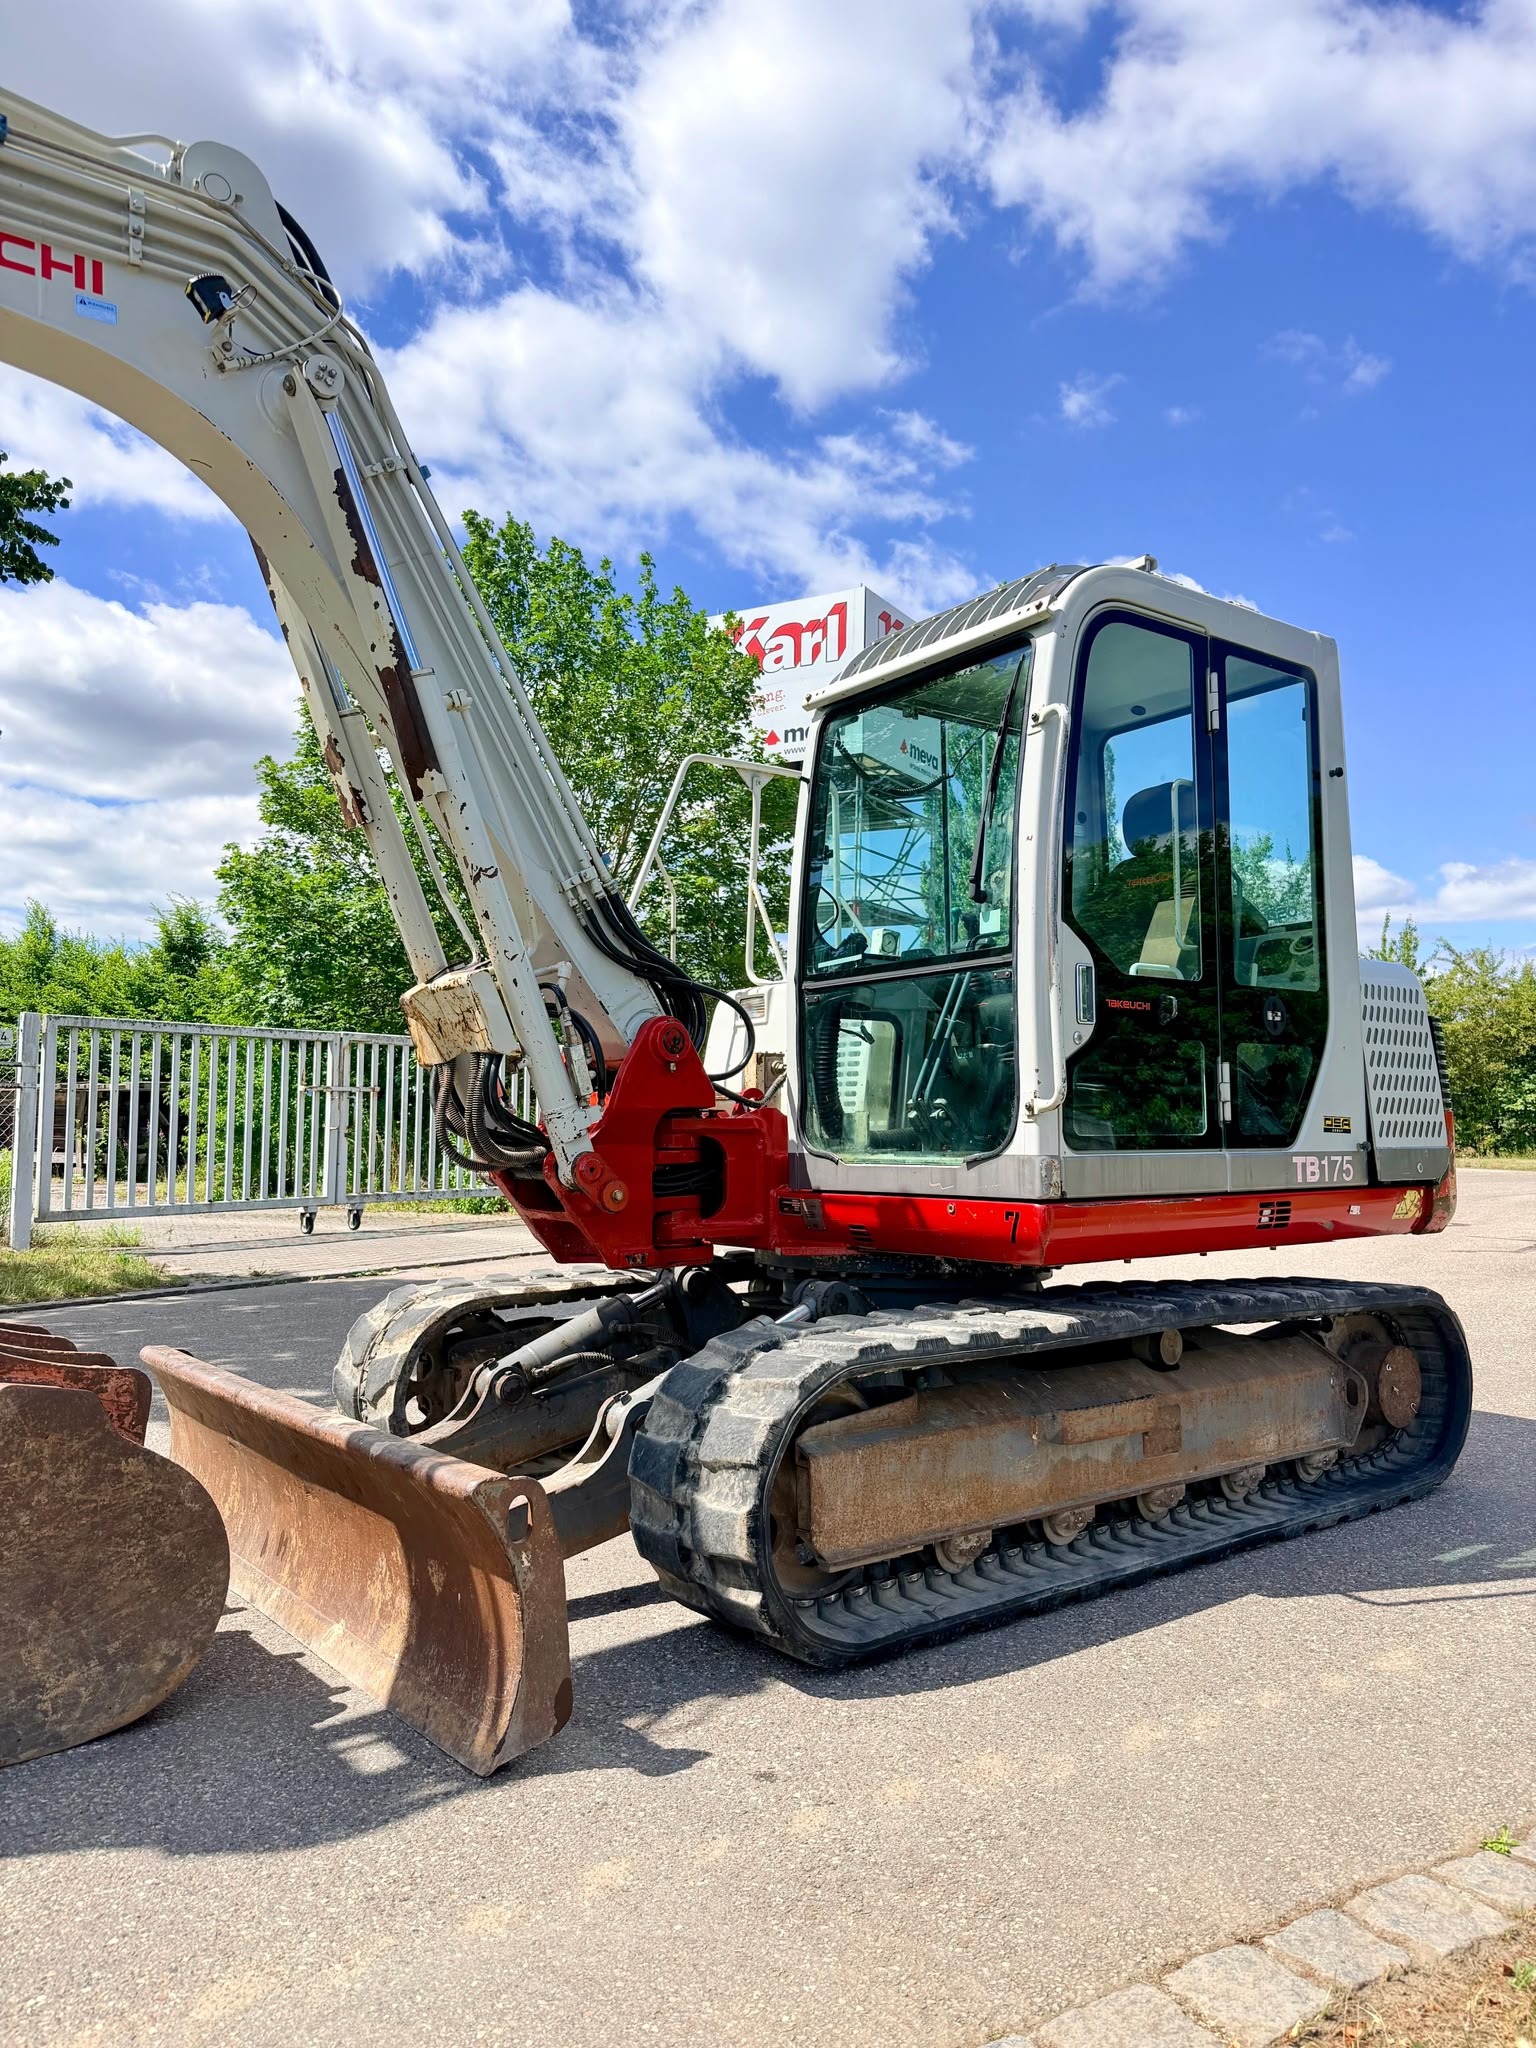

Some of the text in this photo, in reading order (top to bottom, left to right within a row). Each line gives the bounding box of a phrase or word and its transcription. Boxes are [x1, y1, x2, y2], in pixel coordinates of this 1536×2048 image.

[0, 231, 103, 296] CHI
[909, 743, 939, 771] meva
[1292, 1155, 1354, 1183] TB175
[1004, 1210, 1020, 1244] 7
